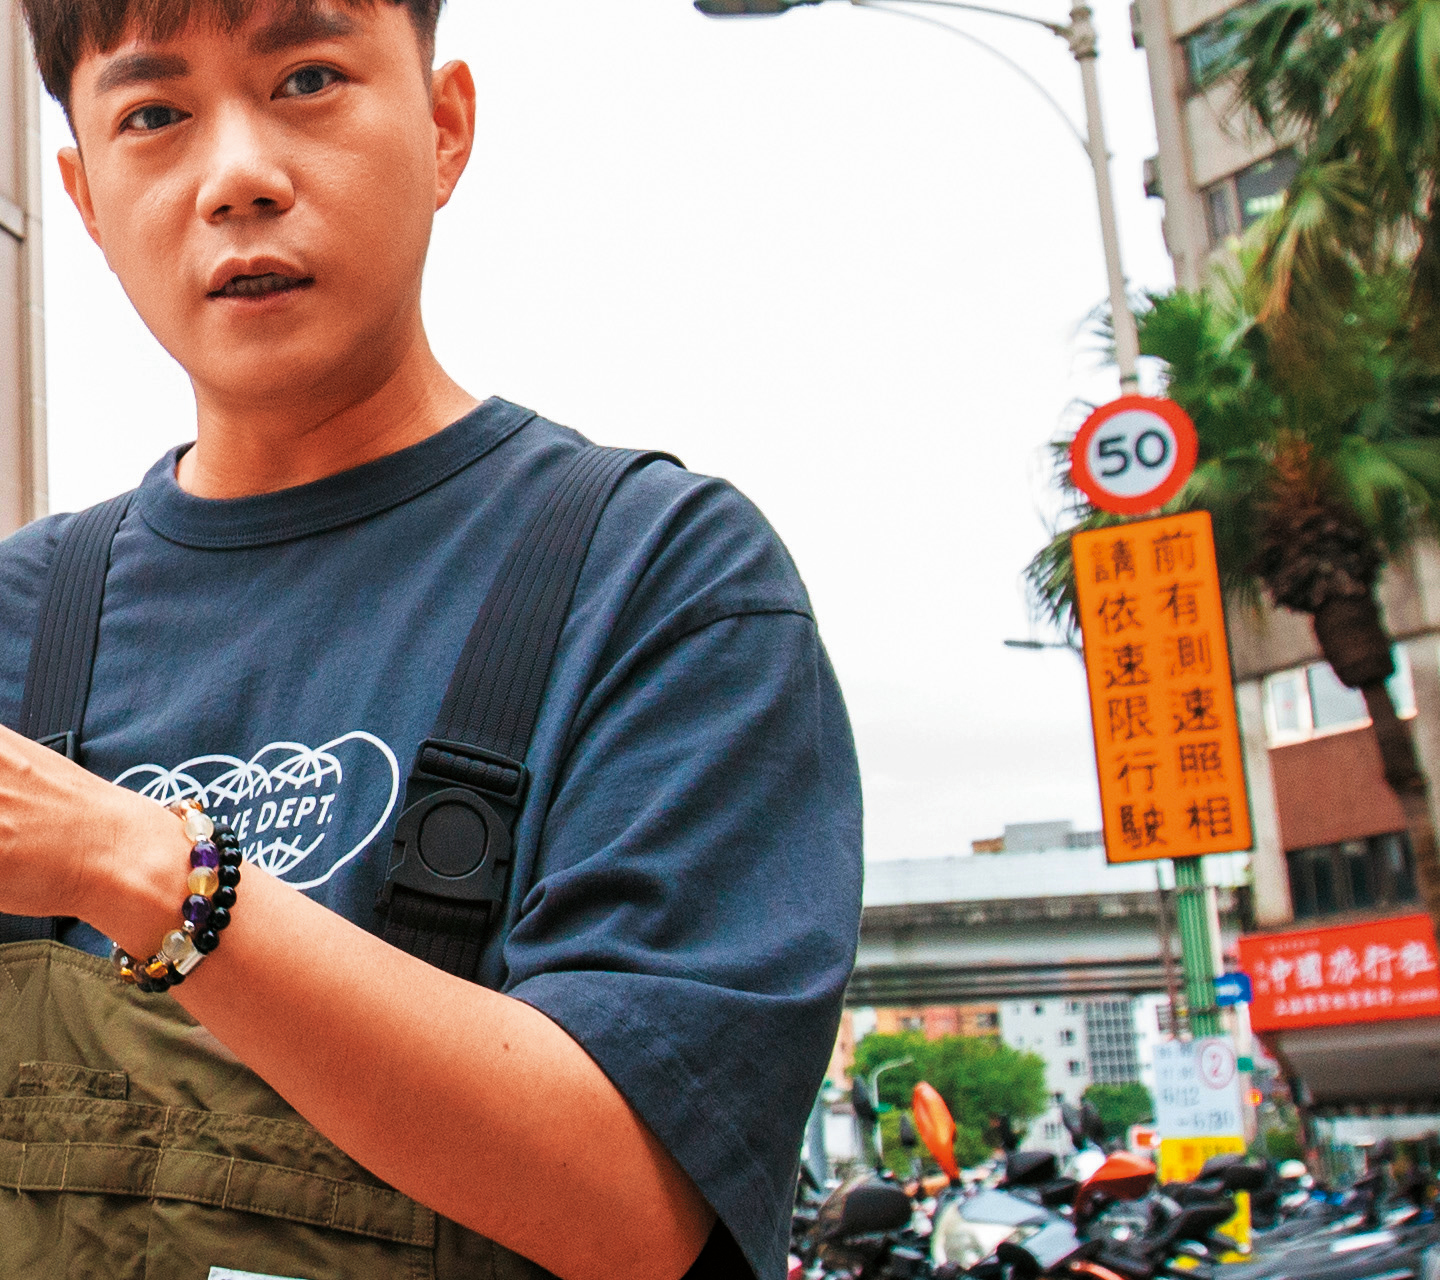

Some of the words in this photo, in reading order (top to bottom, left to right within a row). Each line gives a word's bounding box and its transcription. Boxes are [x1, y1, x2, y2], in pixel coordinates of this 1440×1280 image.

[1097, 429, 1170, 478] 50
[1090, 538, 1168, 852] 請依速限行駛
[1151, 529, 1235, 841] 前有測速照相
[255, 793, 336, 834] DEPT.
